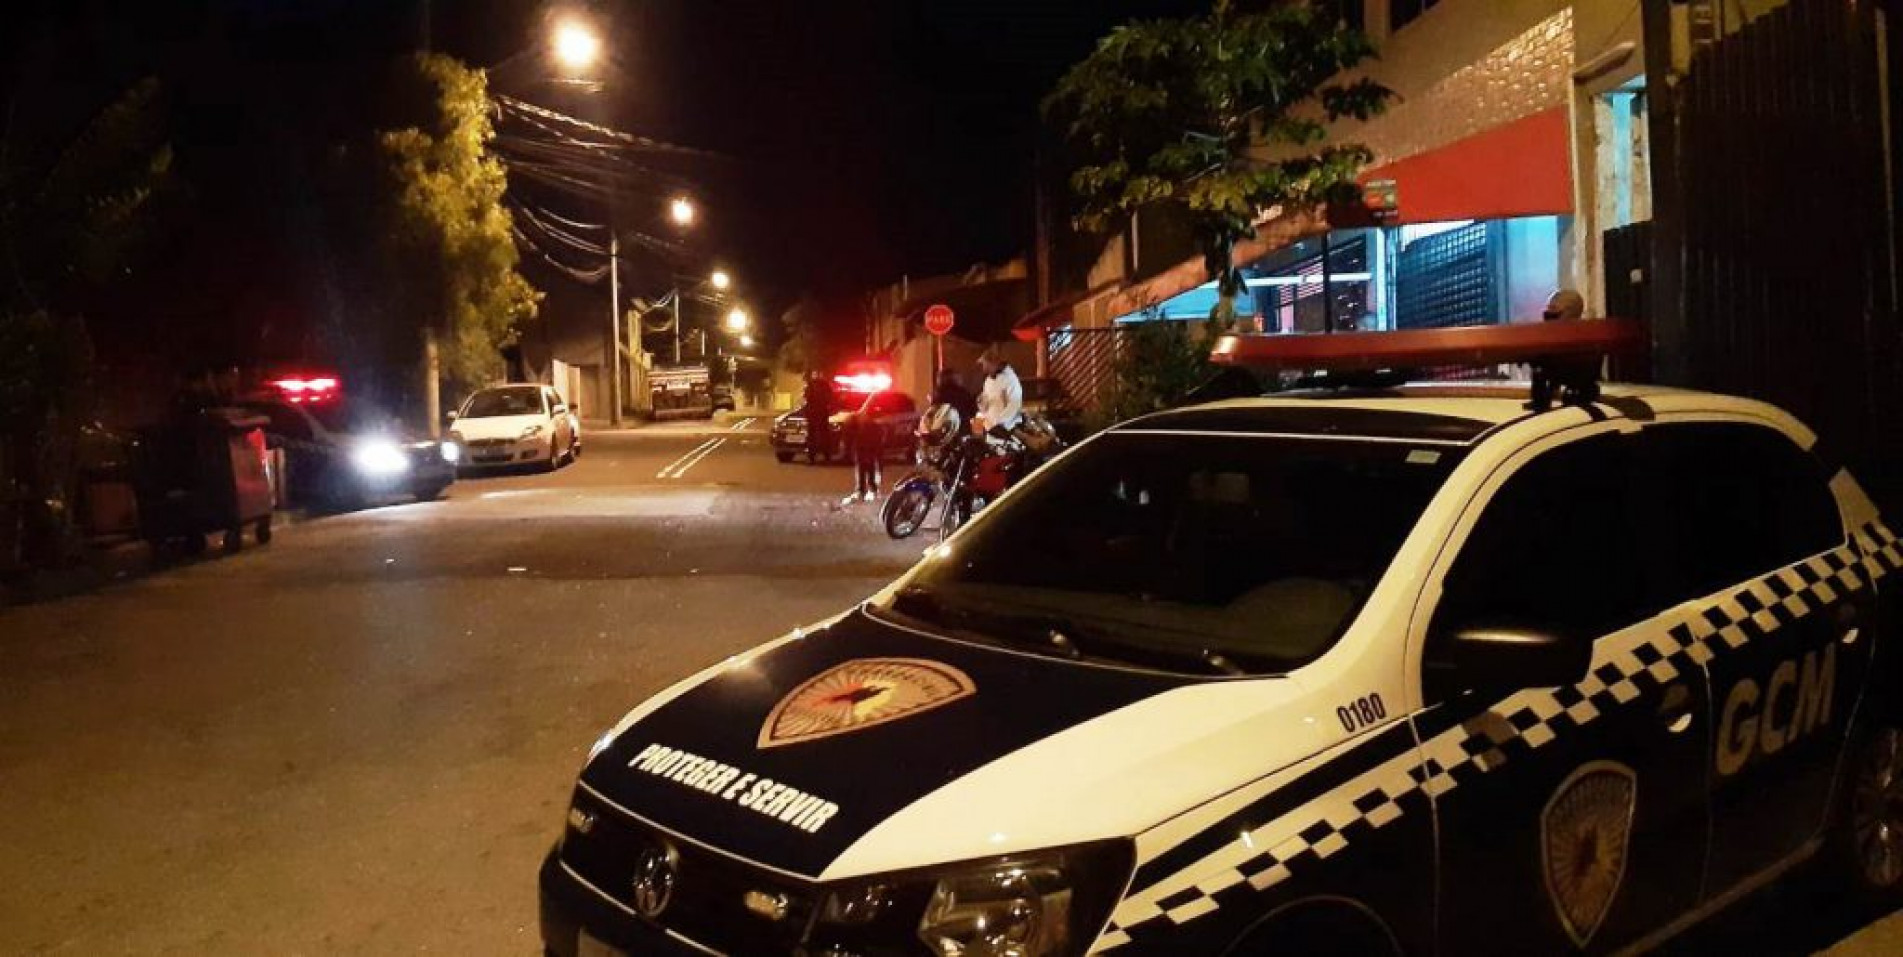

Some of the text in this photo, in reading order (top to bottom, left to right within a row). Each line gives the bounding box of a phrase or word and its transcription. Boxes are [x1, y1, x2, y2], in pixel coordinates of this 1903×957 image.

[1336, 692, 1386, 732] 0180
[1717, 643, 1836, 775] GCM
[627, 743, 839, 834] PROTEGER E SERVIR
